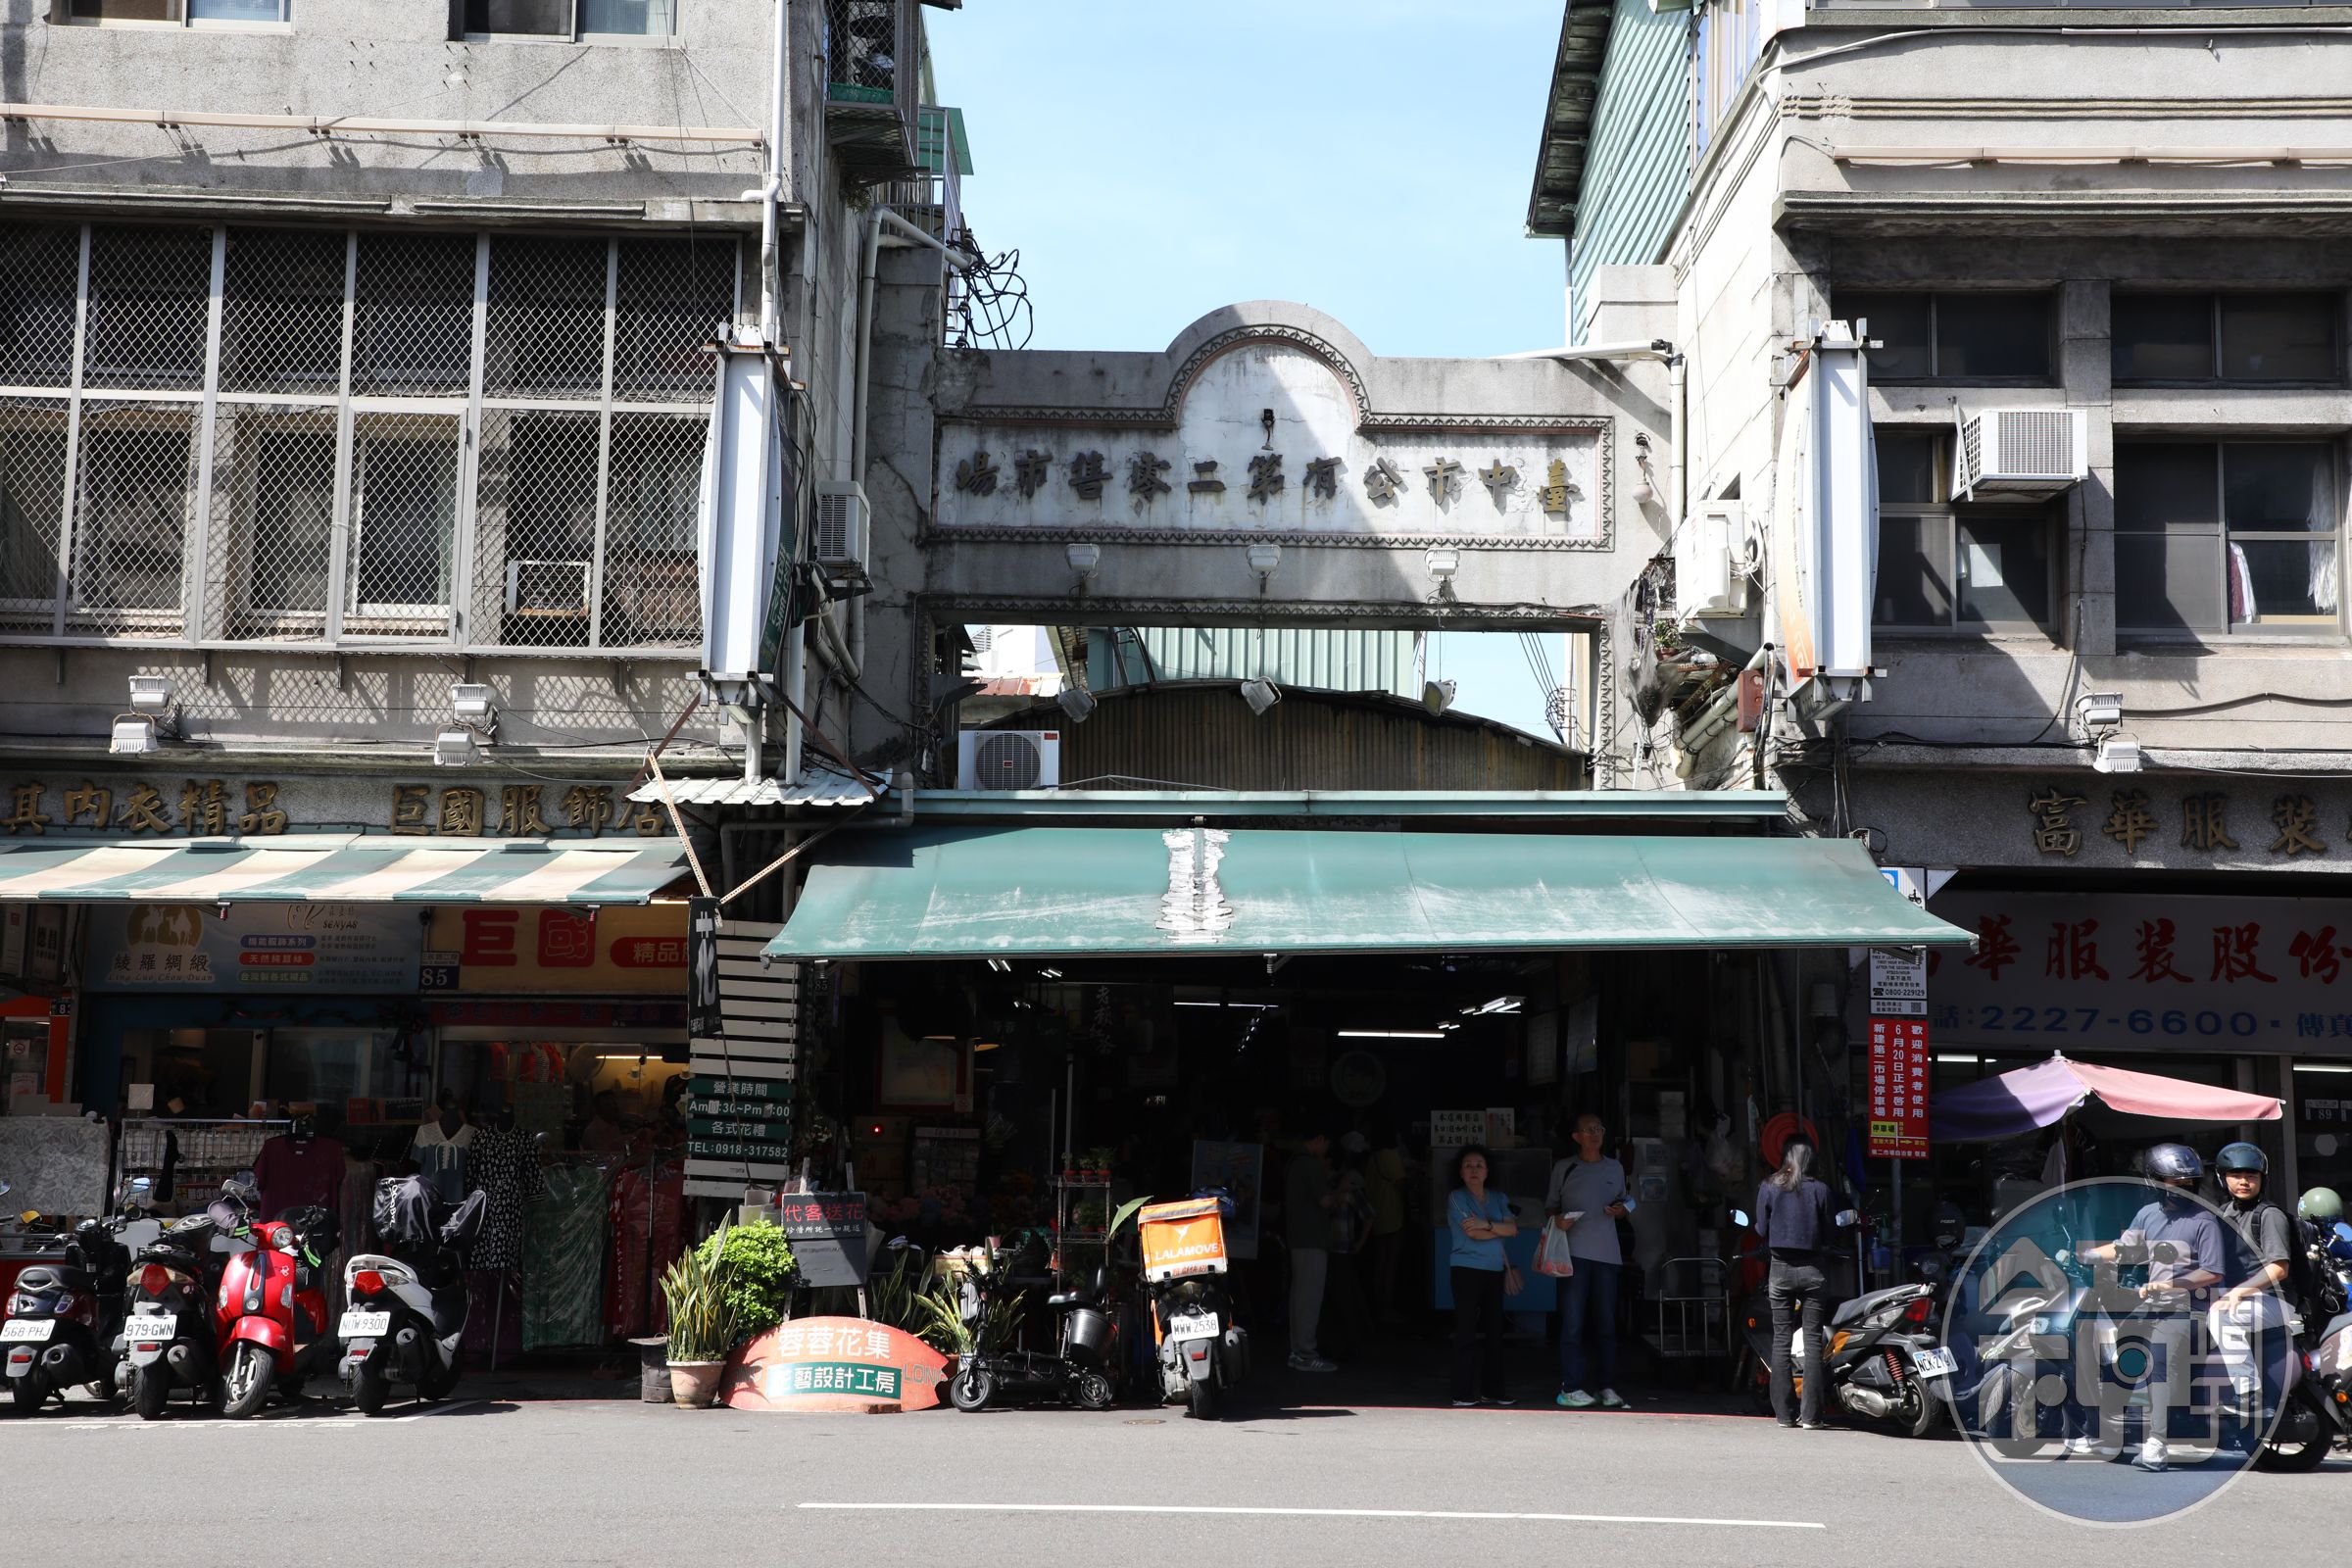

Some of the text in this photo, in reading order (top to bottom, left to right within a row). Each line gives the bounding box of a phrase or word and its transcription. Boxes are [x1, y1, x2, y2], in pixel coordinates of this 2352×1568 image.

[390, 783, 668, 837] 巨國服飾店
[2029, 786, 2352, 857] 富華服裝
[1928, 913, 2352, 986] 華服裝股份
[421, 968, 448, 986] 85
[1874, 1023, 1886, 1117] 新建第二市場停車場
[1911, 1025, 1924, 1118] 歡迎消費者使用
[712, 1081, 768, 1097] 營業時間
[711, 1121, 766, 1137] 各式花禮
[784, 1203, 863, 1223] 代客送花
[1154, 1243, 1219, 1261] LALAMOVE
[777, 1325, 891, 1359] 蓉蓉花集
